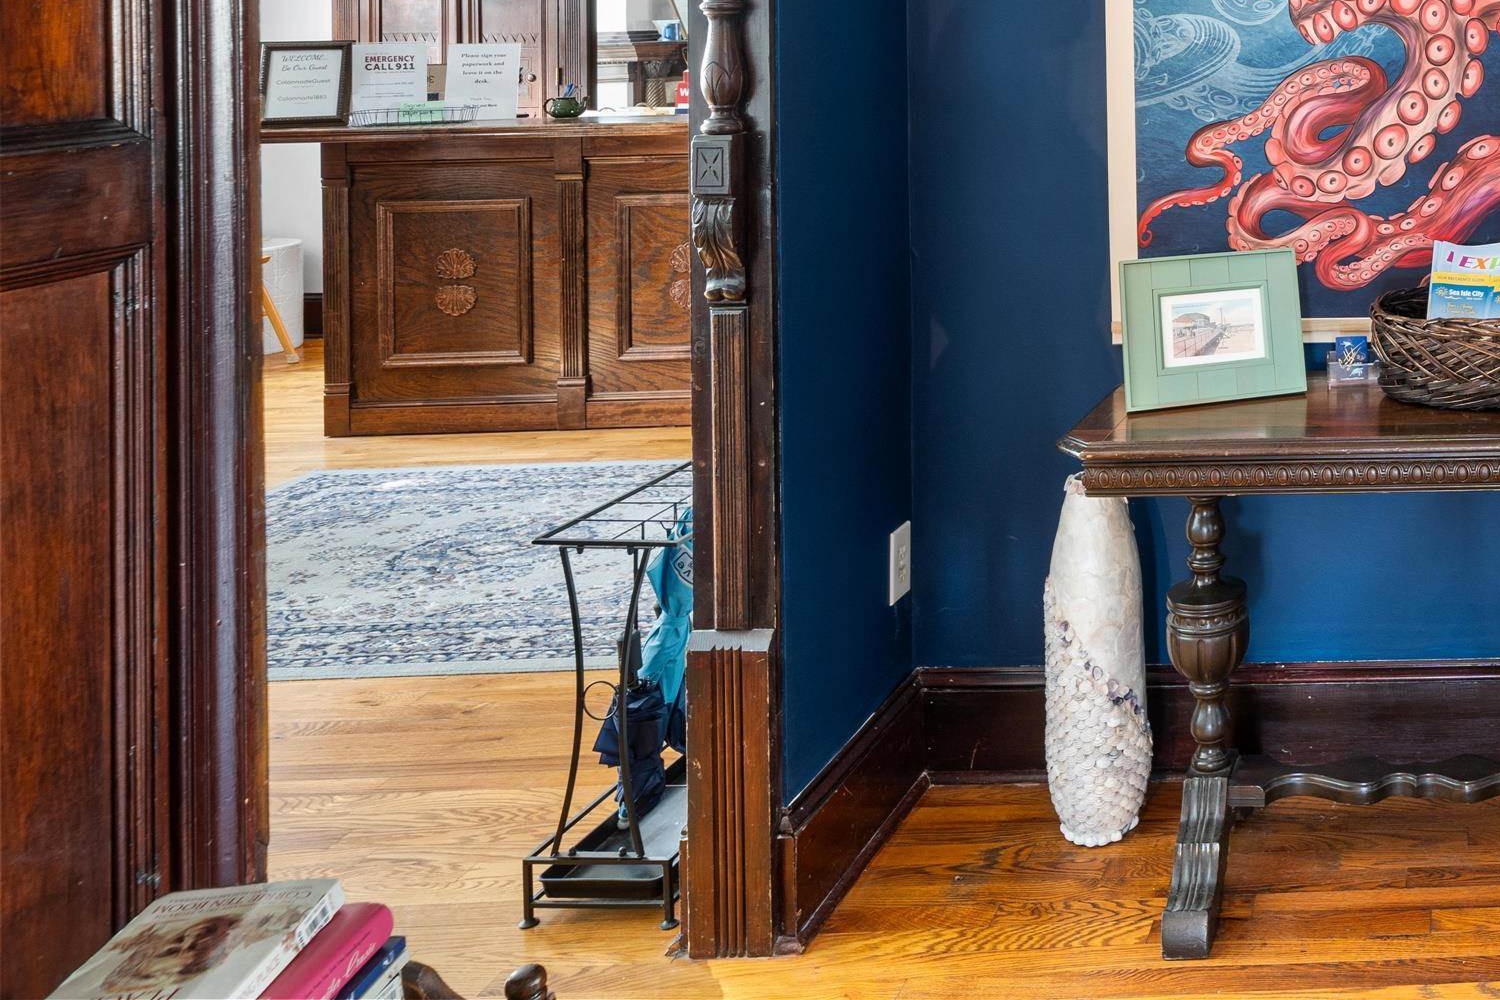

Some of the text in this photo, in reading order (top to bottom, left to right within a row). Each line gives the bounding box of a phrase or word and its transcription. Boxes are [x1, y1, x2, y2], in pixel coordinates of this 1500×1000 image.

[364, 55, 415, 63] EMERGENCY
[365, 62, 415, 71] CALL 911
[1449, 288, 1484, 298] Sea Isle City
